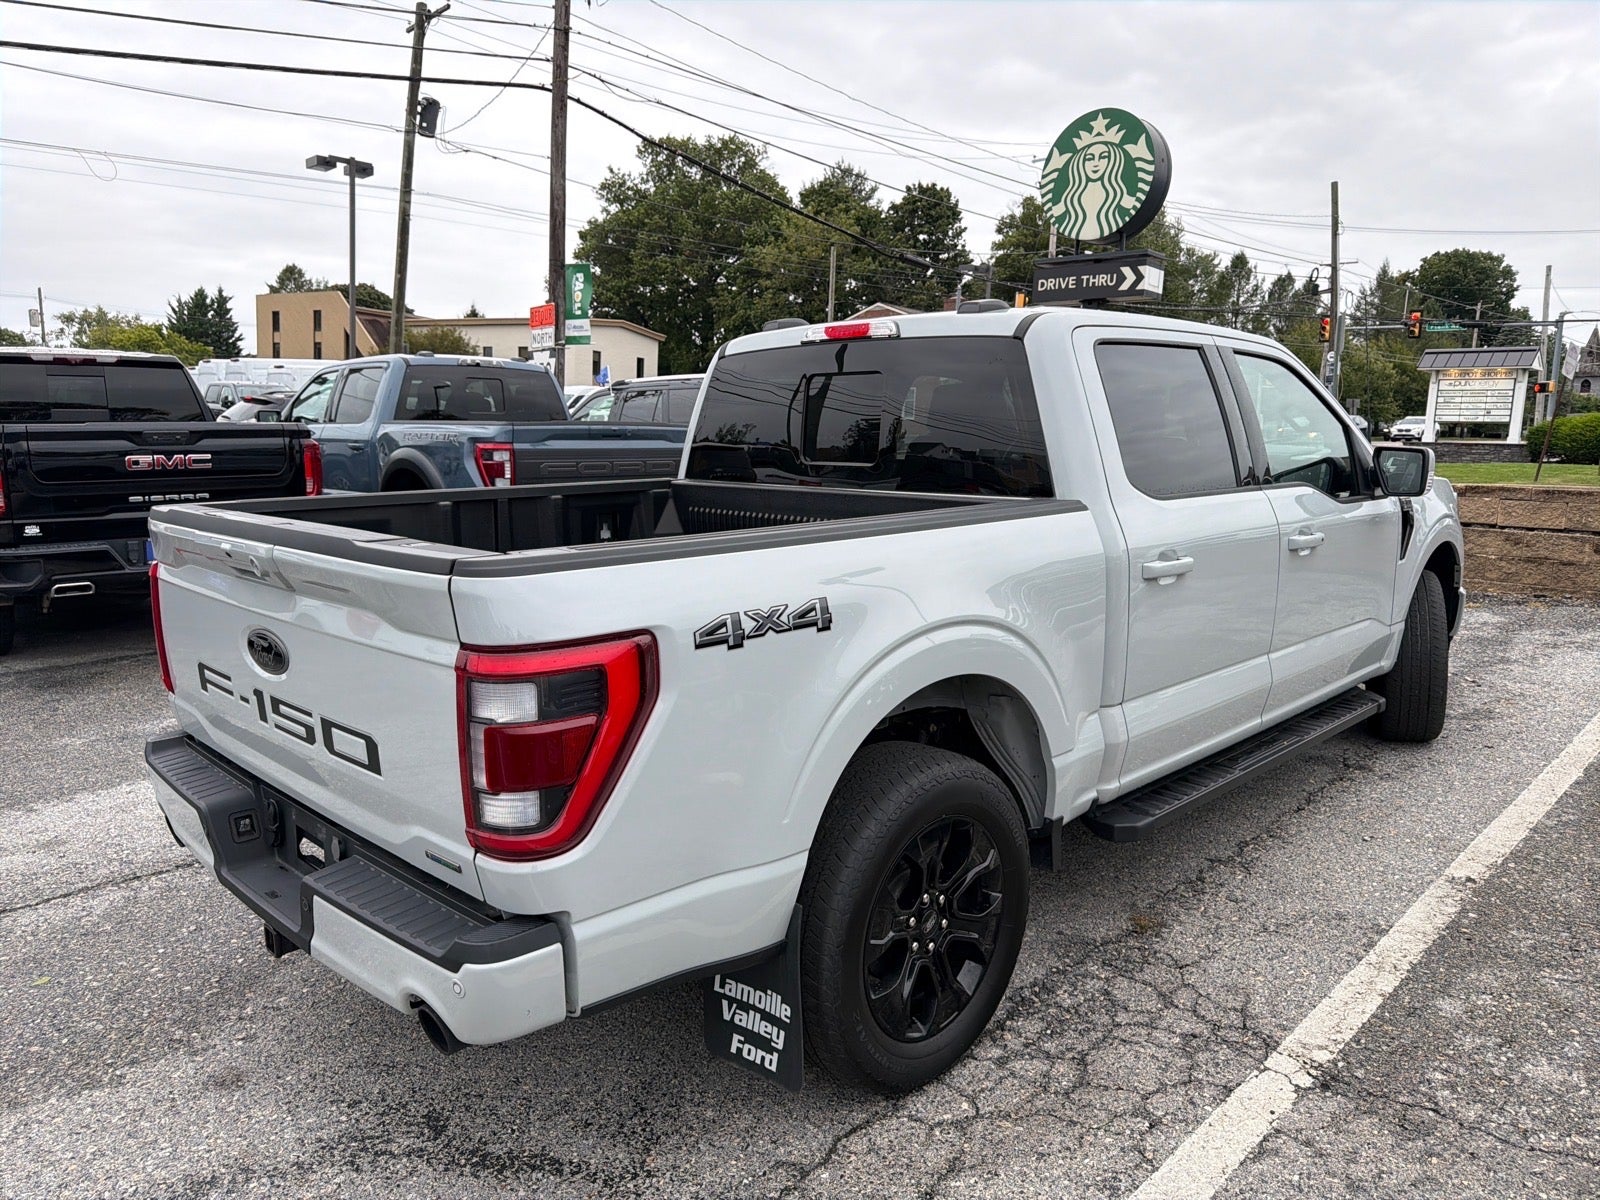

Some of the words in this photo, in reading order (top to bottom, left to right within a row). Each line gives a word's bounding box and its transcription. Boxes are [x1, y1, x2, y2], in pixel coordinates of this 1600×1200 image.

[1037, 276, 1077, 292] DRIVE
[1080, 273, 1117, 288] THRU
[574, 272, 584, 315] PAOLI
[531, 308, 553, 323] DETOUR
[532, 332, 553, 345] NORTH
[125, 453, 213, 471] GMC
[540, 460, 677, 476] FORD
[128, 492, 210, 503] SIERRA
[197, 661, 383, 778] F-150
[713, 973, 792, 1024] Lamoille
[721, 998, 786, 1051] Valley
[729, 1032, 779, 1073] Ford
